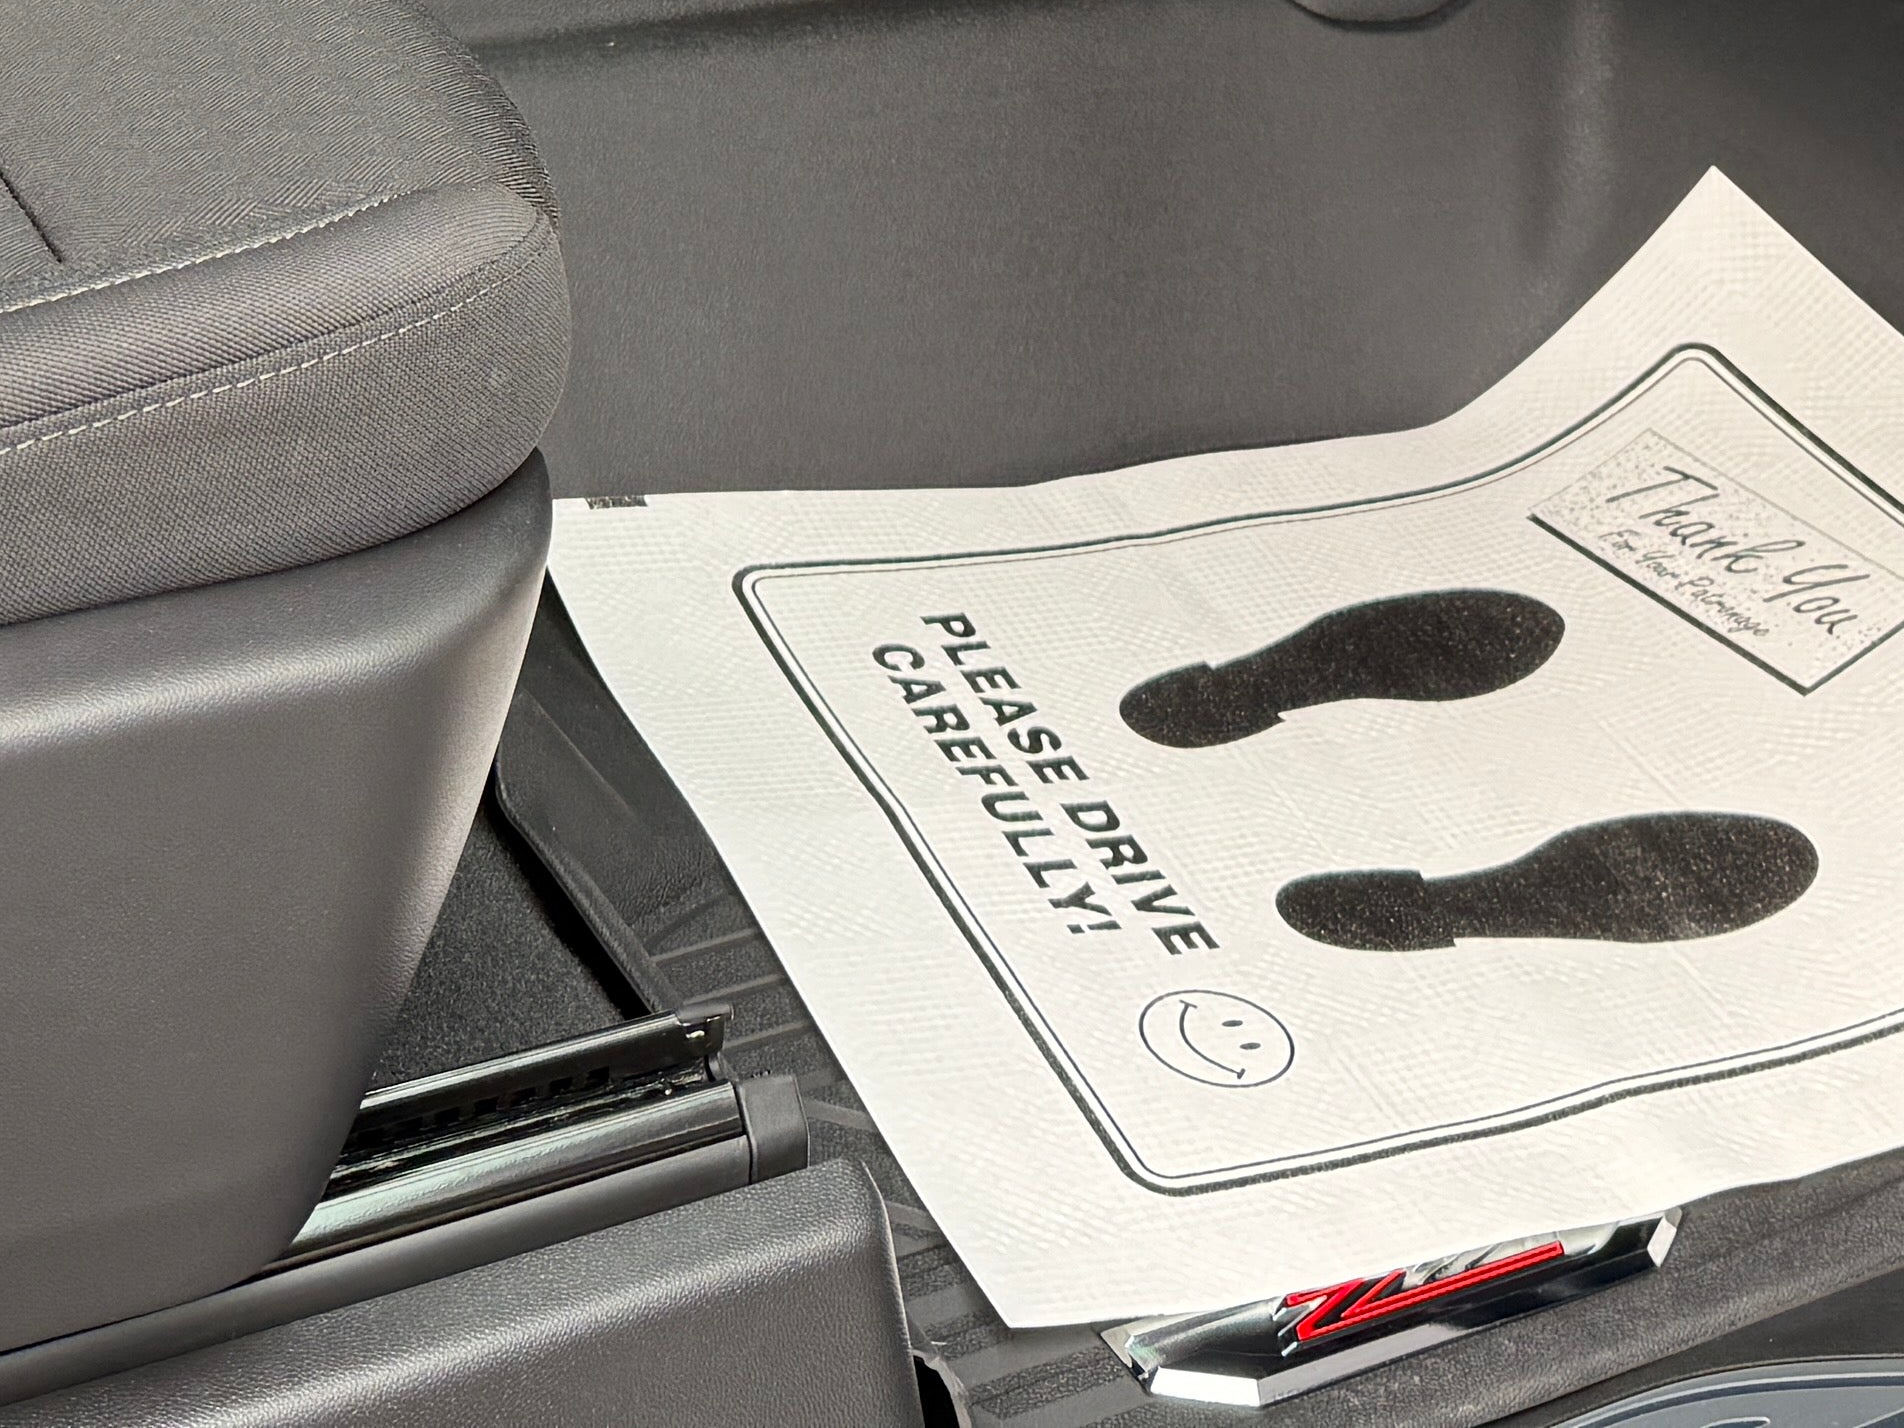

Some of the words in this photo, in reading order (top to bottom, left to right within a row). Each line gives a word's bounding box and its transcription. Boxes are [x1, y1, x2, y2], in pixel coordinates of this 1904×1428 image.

[1598, 528, 1642, 553] For
[1606, 466, 1805, 574] Thank
[1763, 563, 1871, 635] You
[871, 643, 1123, 935] CAREFULLY!
[920, 611, 1091, 785] PLEASE
[1060, 799, 1221, 956] DRIVE
